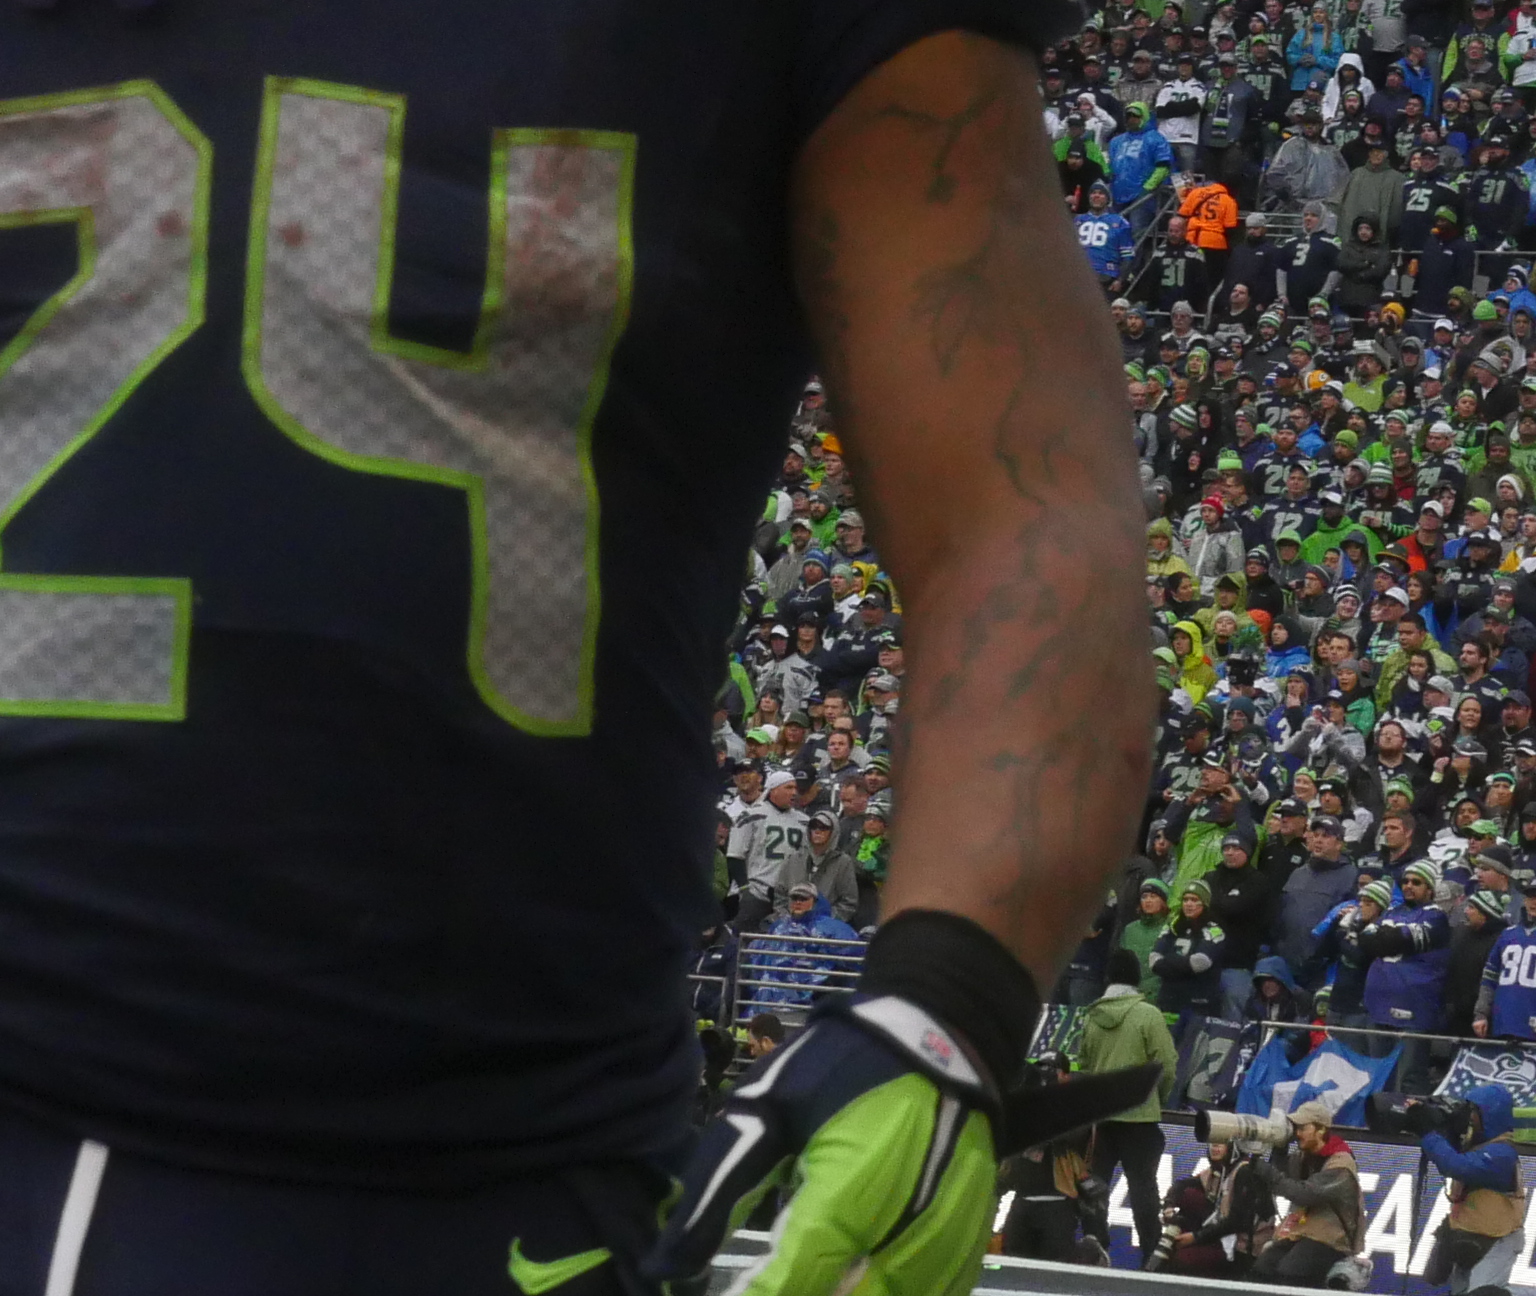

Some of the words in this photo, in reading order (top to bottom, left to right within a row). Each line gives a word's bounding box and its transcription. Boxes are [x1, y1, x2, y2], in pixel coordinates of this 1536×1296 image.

[1406, 188, 1433, 212] 25
[1478, 179, 1506, 204] 31
[1079, 221, 1110, 247] 96
[1293, 242, 1311, 267] 3
[1161, 257, 1186, 288] 31
[1274, 717, 1292, 752] 3
[765, 825, 803, 861] 29
